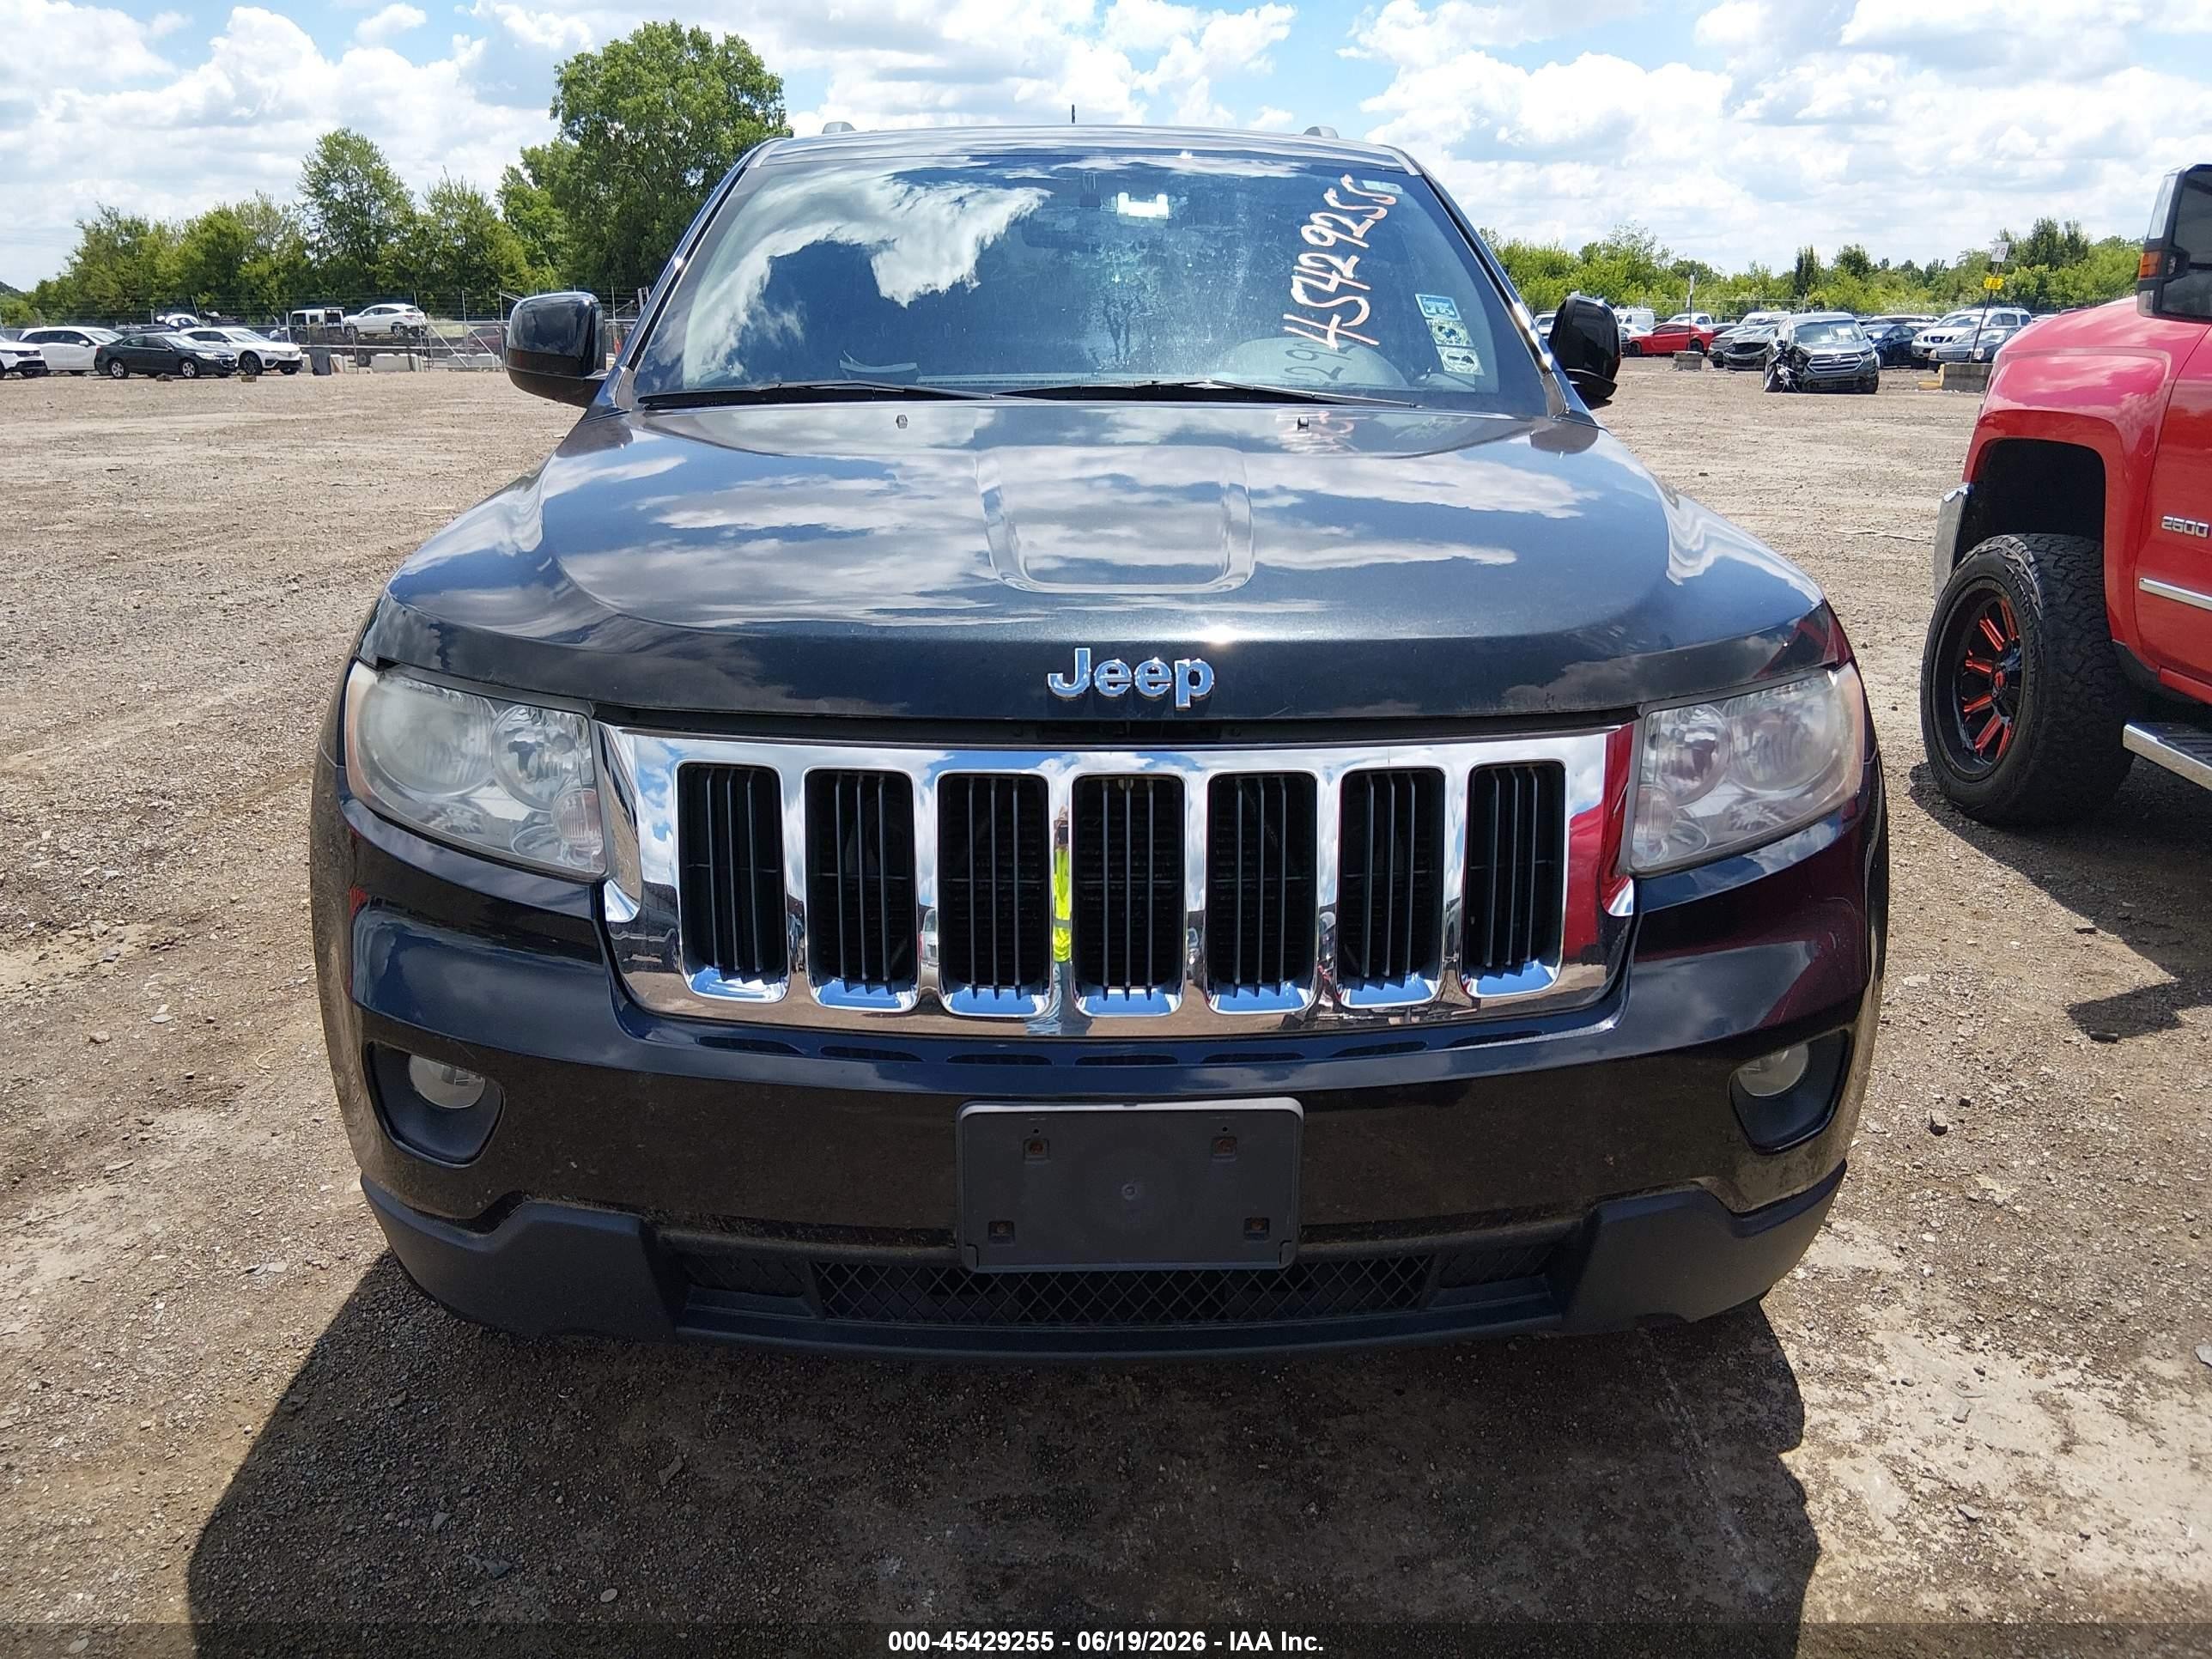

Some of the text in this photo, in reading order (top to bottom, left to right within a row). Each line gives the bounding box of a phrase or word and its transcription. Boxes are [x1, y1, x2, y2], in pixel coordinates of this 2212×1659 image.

[1283, 173, 1397, 350] 45429255
[2161, 515, 2209, 538] 2500
[1047, 647, 1215, 708] Jeep
